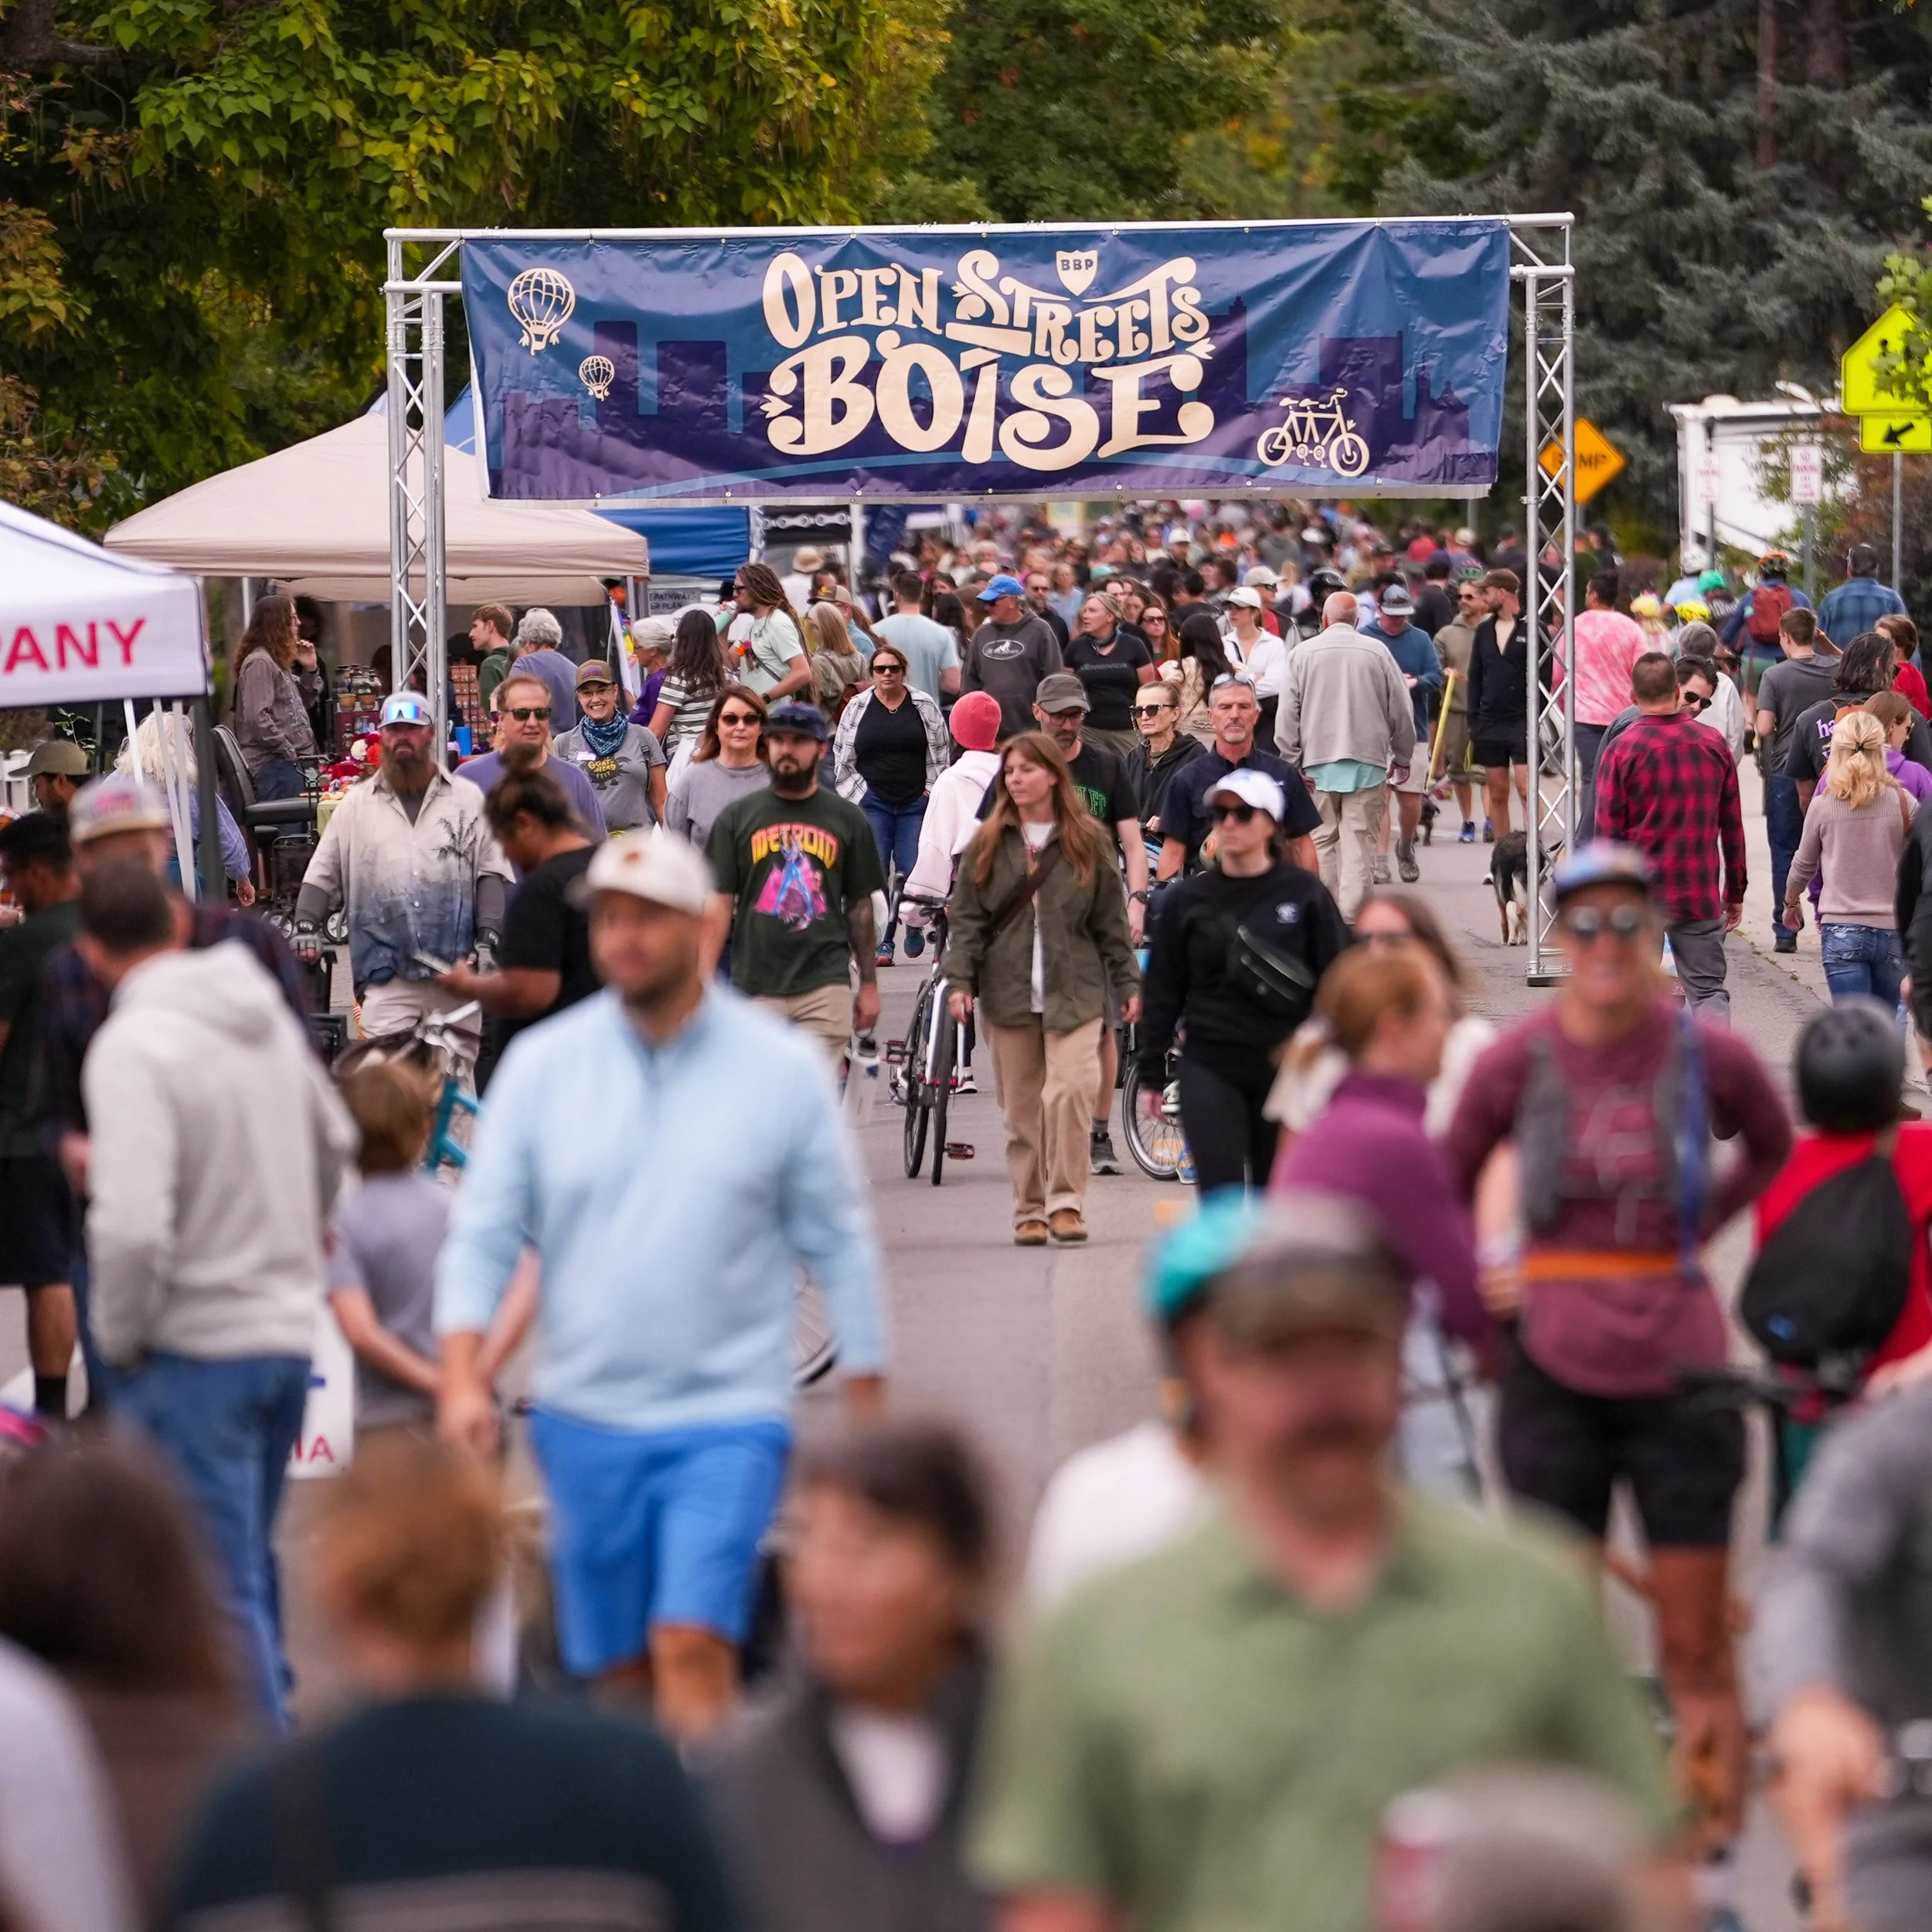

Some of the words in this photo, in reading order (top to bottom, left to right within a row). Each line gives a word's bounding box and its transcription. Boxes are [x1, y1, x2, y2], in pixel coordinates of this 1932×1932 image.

[1061, 259, 1094, 271] BBP
[763, 252, 943, 349] OPEN
[946, 249, 1210, 366] STREETS
[765, 329, 1216, 471] BOISE
[1551, 452, 1607, 470] BMP
[0, 617, 147, 675] ANY
[750, 822, 839, 870] METROID
